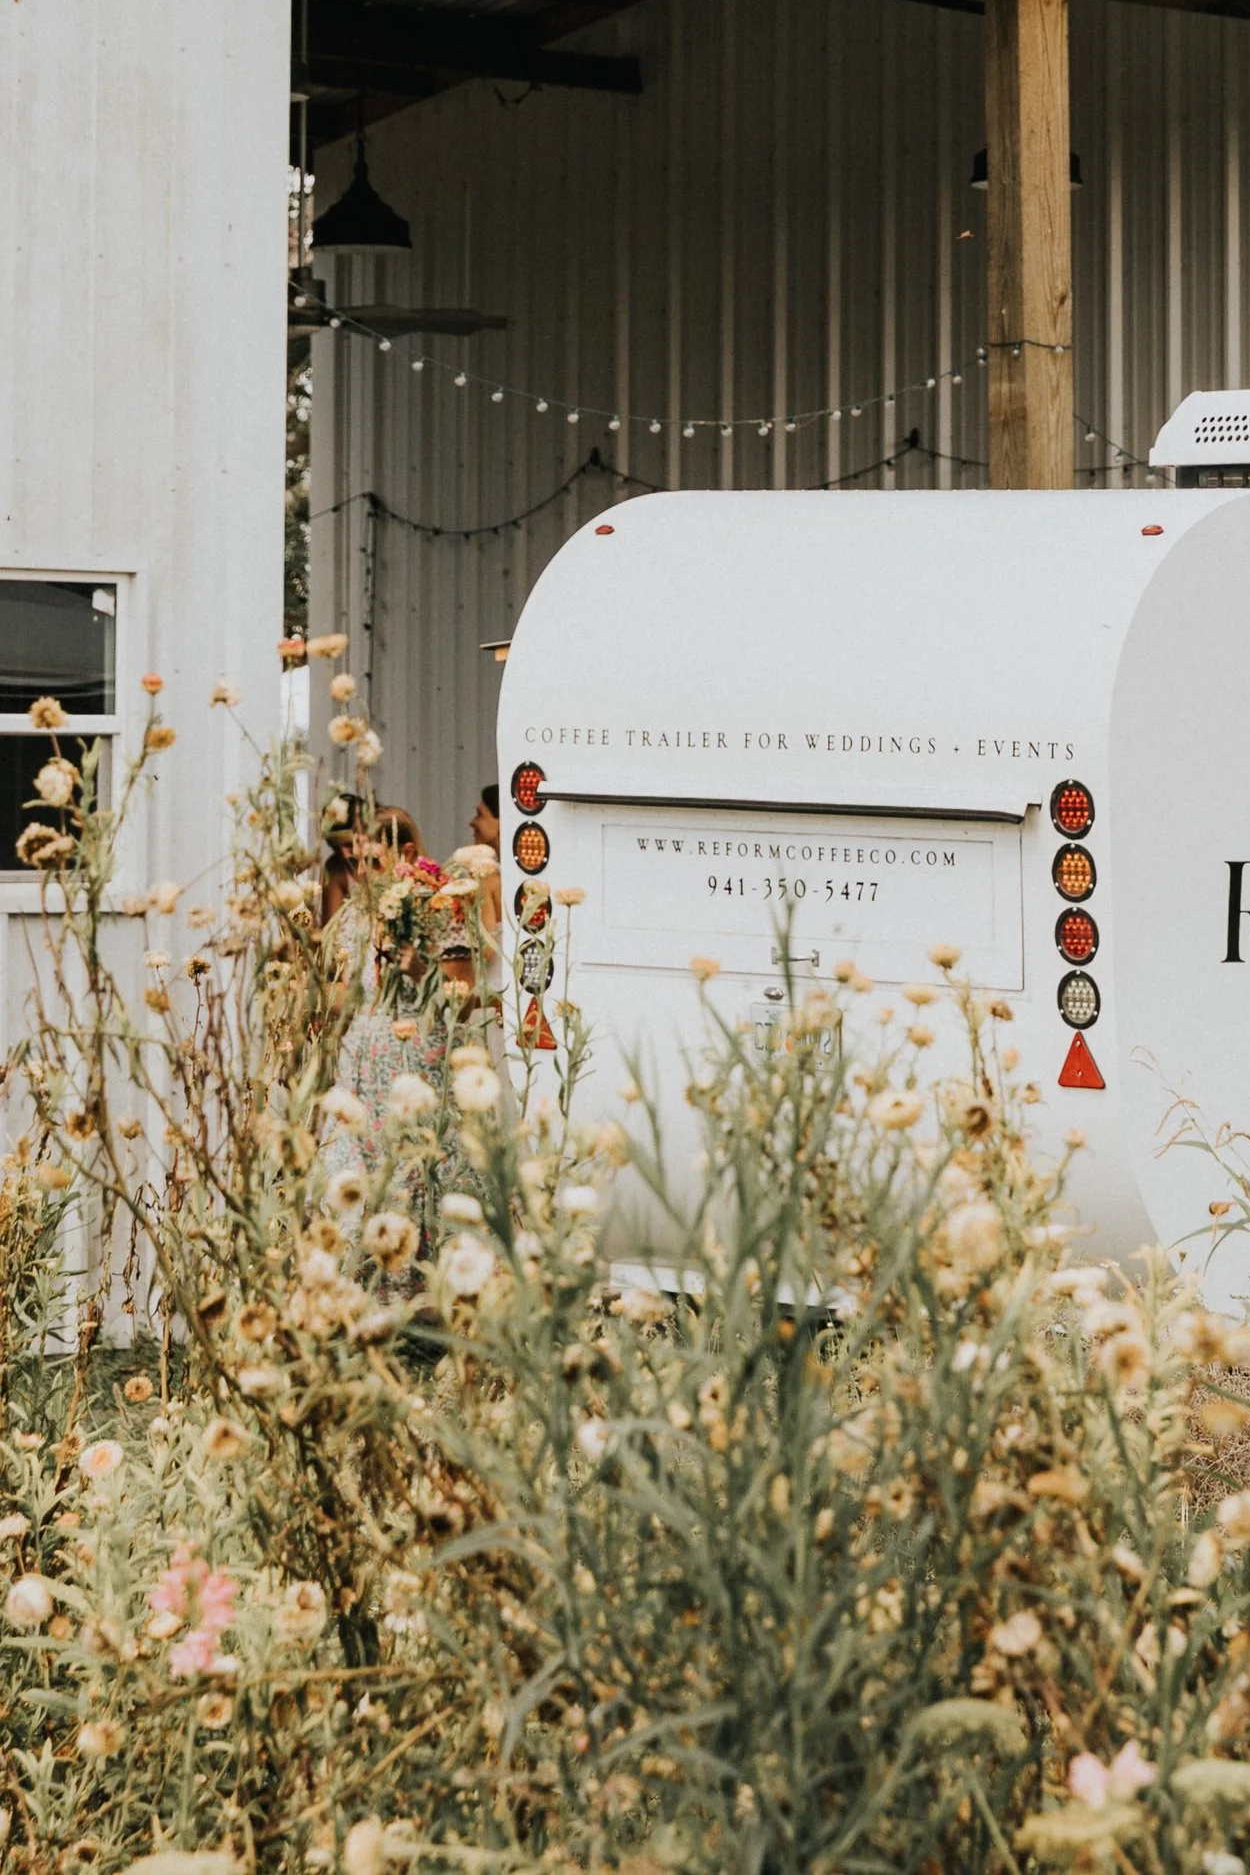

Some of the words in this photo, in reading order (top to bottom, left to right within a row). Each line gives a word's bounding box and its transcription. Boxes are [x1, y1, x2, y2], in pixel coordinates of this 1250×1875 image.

[525, 727, 611, 746] COFFEE
[625, 729, 729, 749] TRAILER
[744, 732, 789, 750] FOR
[804, 734, 937, 755] WEDDINGS
[977, 739, 1075, 761] EVENTS
[637, 837, 957, 867] WWW.REFORMCOFFEECO.COM
[708, 875, 879, 902] 941-350-5477
